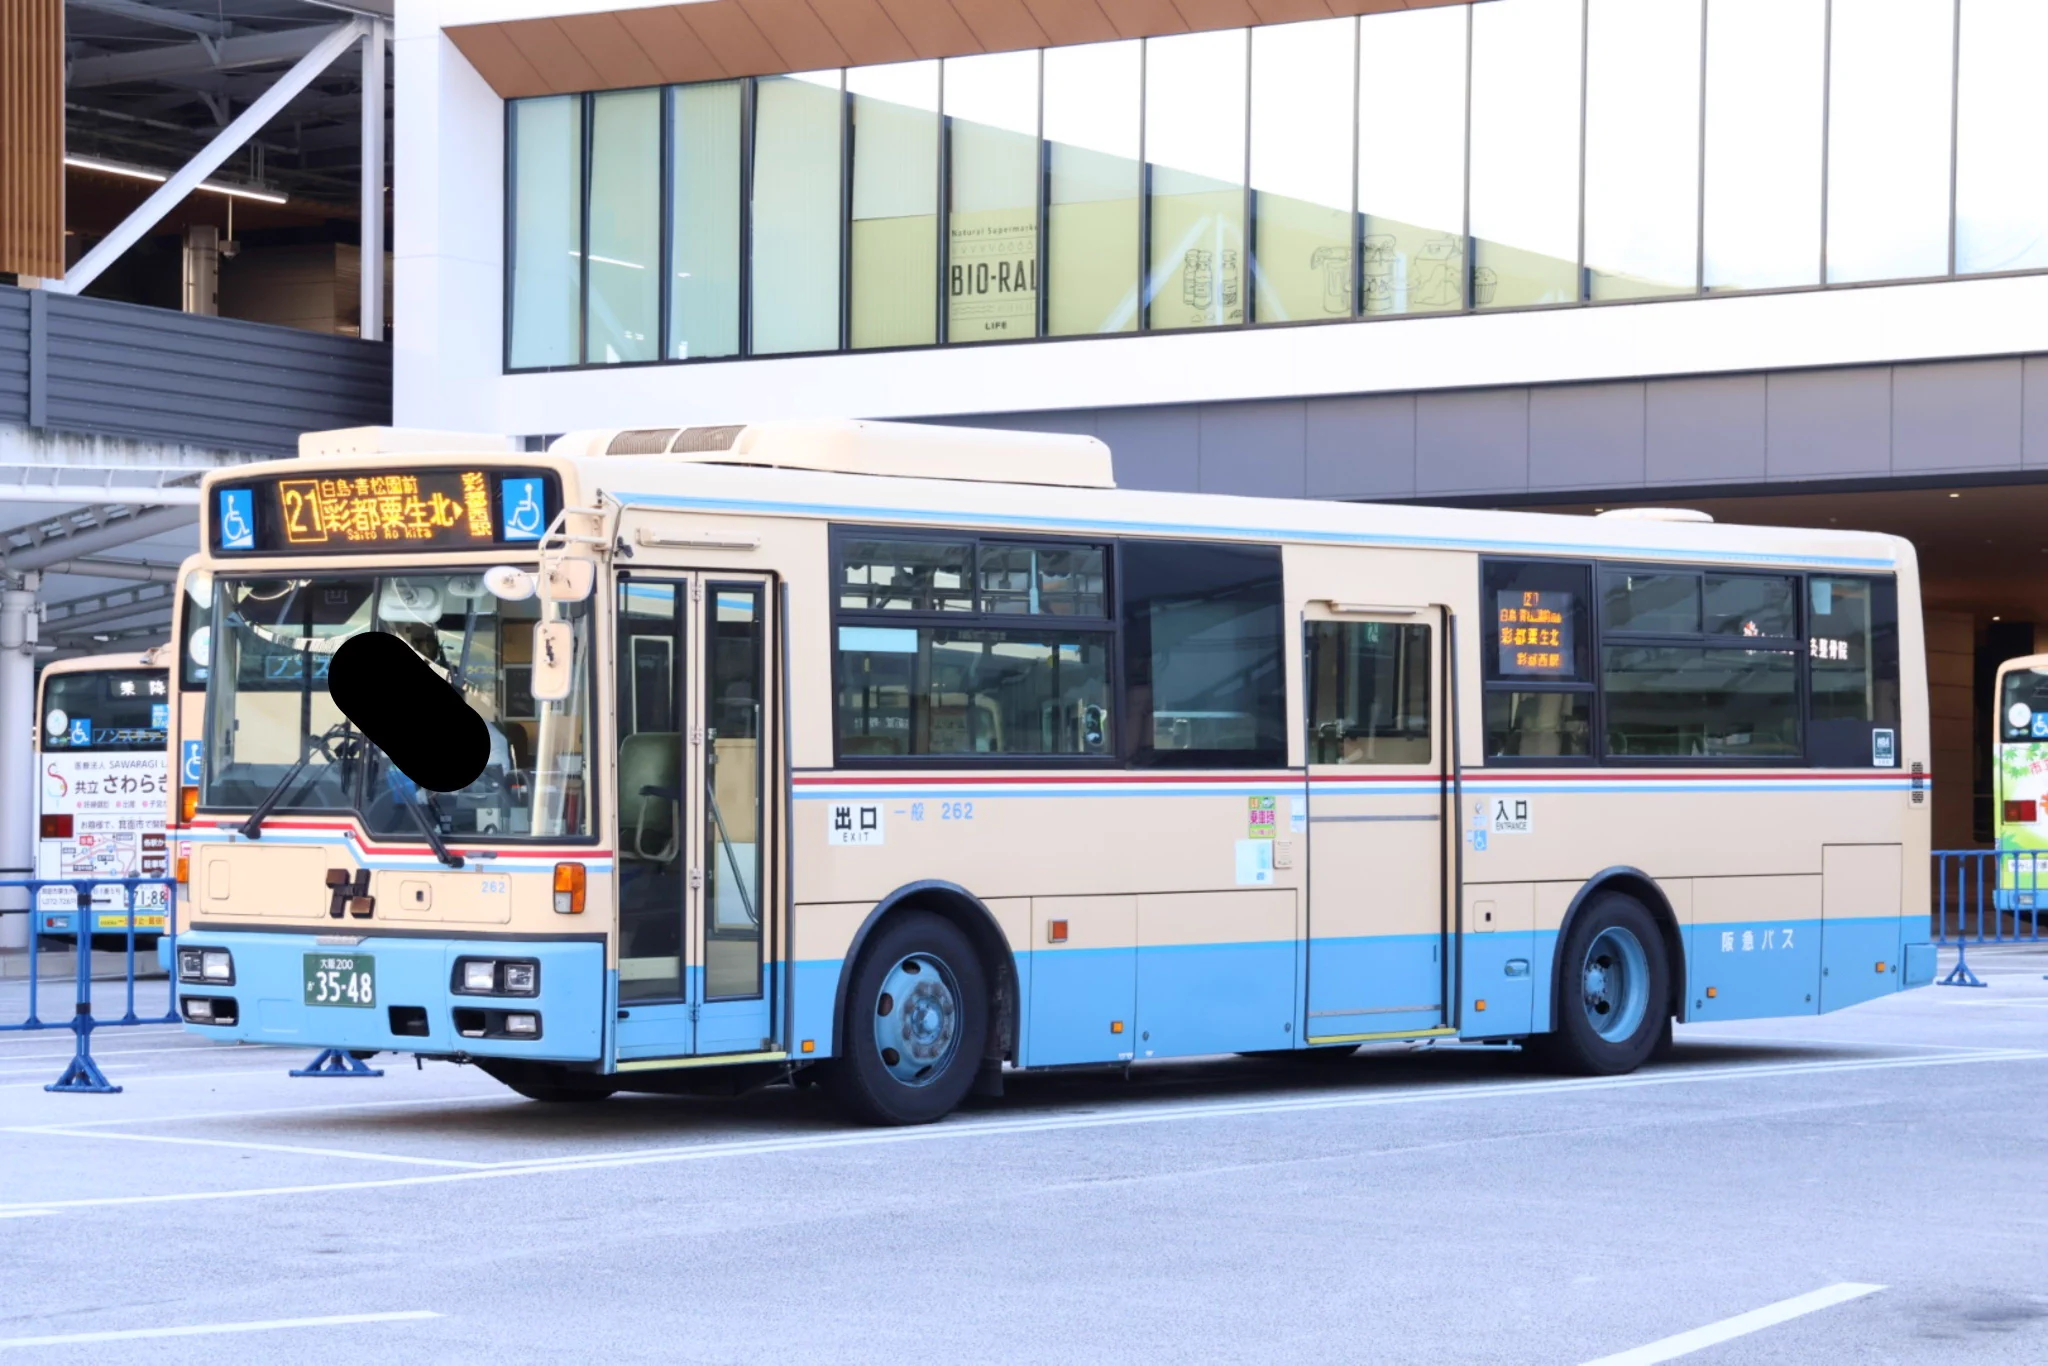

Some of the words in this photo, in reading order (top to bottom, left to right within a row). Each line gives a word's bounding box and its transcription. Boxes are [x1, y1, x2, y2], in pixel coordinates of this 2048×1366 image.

[951, 227, 985, 237] Natural
[984, 321, 1008, 331] LIFE
[285, 488, 322, 533] 21
[347, 527, 378, 541] Saito
[109, 760, 158, 769] SAWARAGI
[941, 802, 974, 820] 262
[1496, 800, 1527, 820] 入口
[835, 806, 877, 831] 出口
[1496, 821, 1527, 831] ENTRANCE
[843, 832, 870, 842] EXIT
[481, 881, 505, 894] 262
[1721, 928, 1794, 952] 阪急バス
[316, 971, 373, 1003] 35-48
